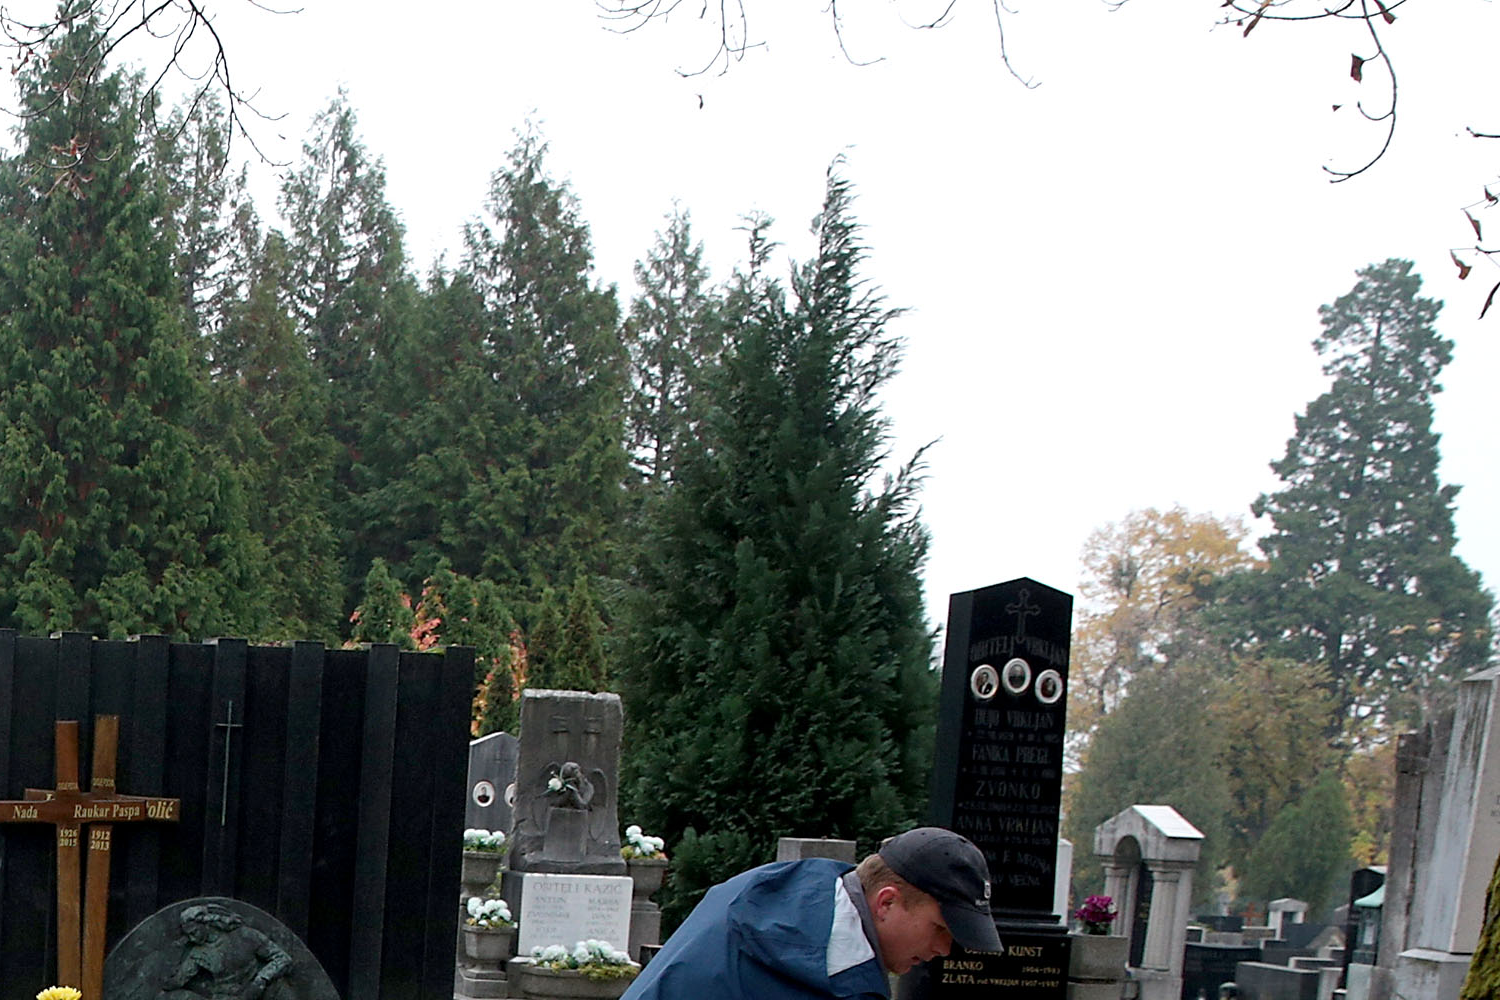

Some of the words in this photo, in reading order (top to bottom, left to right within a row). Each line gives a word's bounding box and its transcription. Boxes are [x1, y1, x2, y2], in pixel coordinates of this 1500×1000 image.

[975, 779, 1041, 799] ZVONKO
[12, 805, 38, 819] Nada
[73, 804, 110, 819] Raukar
[112, 804, 141, 821] Paspa
[145, 800, 173, 819] olić
[91, 830, 111, 840] 1912
[90, 840, 110, 850] 2013
[1008, 945, 1044, 957] KUNST
[943, 959, 984, 971] BRANKO
[941, 973, 975, 985] ZLATA
